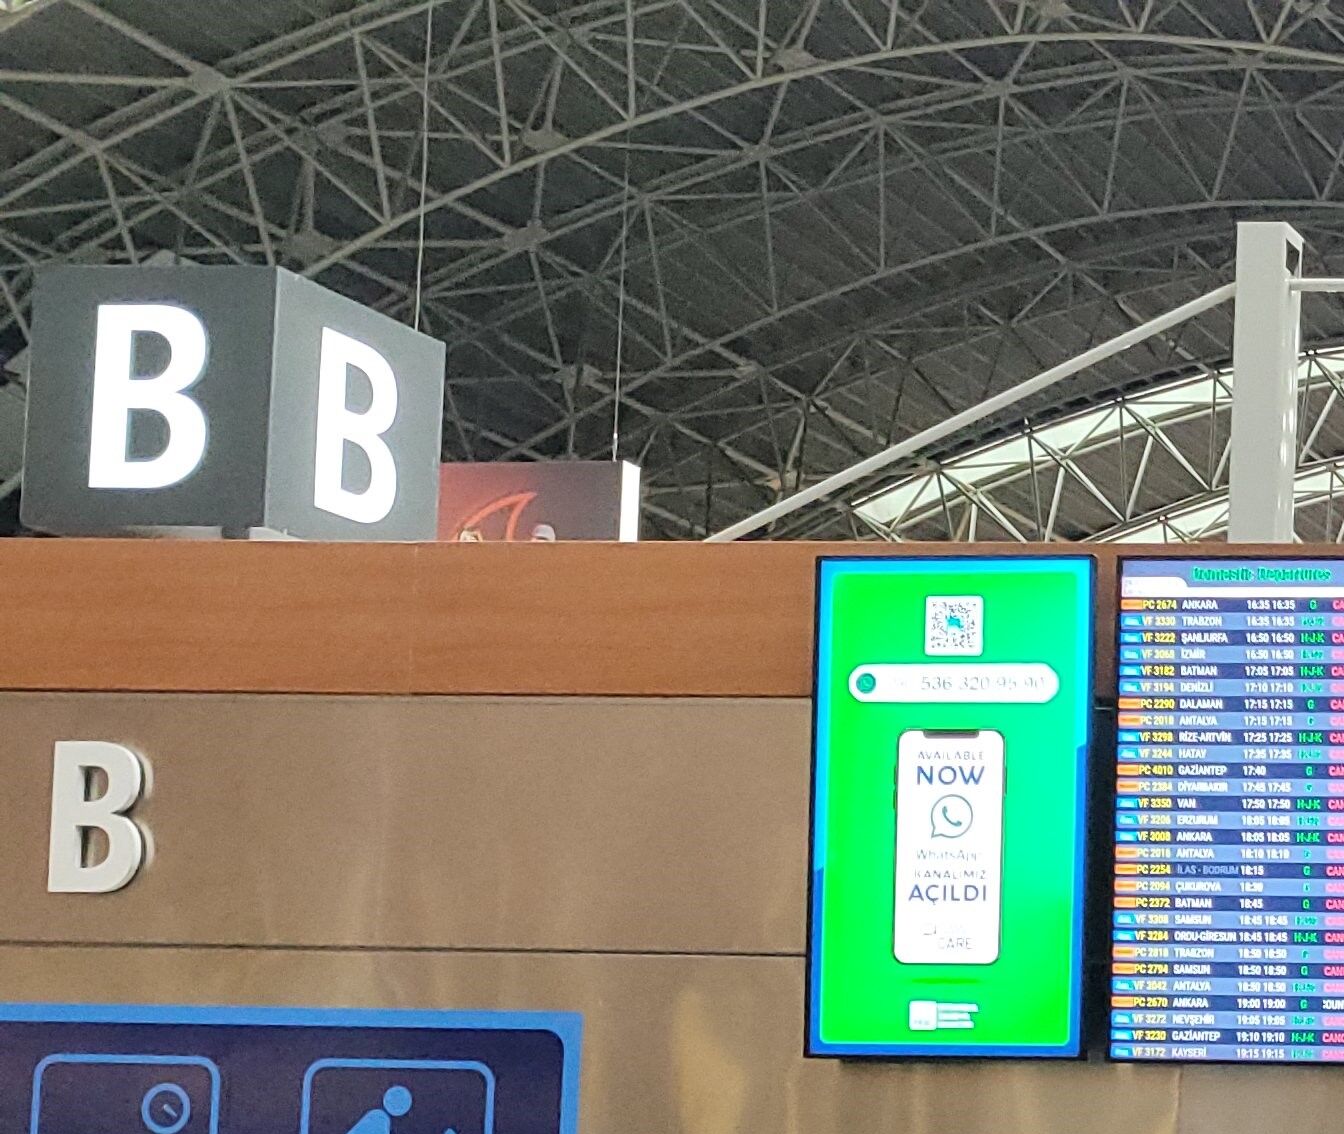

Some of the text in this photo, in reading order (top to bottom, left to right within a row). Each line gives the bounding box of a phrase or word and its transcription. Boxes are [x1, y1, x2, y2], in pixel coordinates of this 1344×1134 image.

[88, 304, 209, 488] B
[314, 327, 398, 523] B
[1182, 600, 1218, 610] ANKARA
[1181, 632, 1228, 645] ŞANLIURFA
[1181, 666, 1217, 676] BATMAN
[1180, 699, 1223, 709] DALAMAN
[918, 751, 984, 760] AVAILABLE
[1178, 763, 1227, 775] GAZİANTEP
[917, 766, 985, 785] NOW
[1177, 798, 1196, 808] VAN
[47, 740, 146, 894] B
[1177, 832, 1212, 842] ANKARA
[909, 884, 986, 905] AÇILDI
[1175, 898, 1212, 908] BATMAN
[1174, 965, 1210, 975] SAMSUN
[1172, 1030, 1220, 1041] GAZİANTEP
